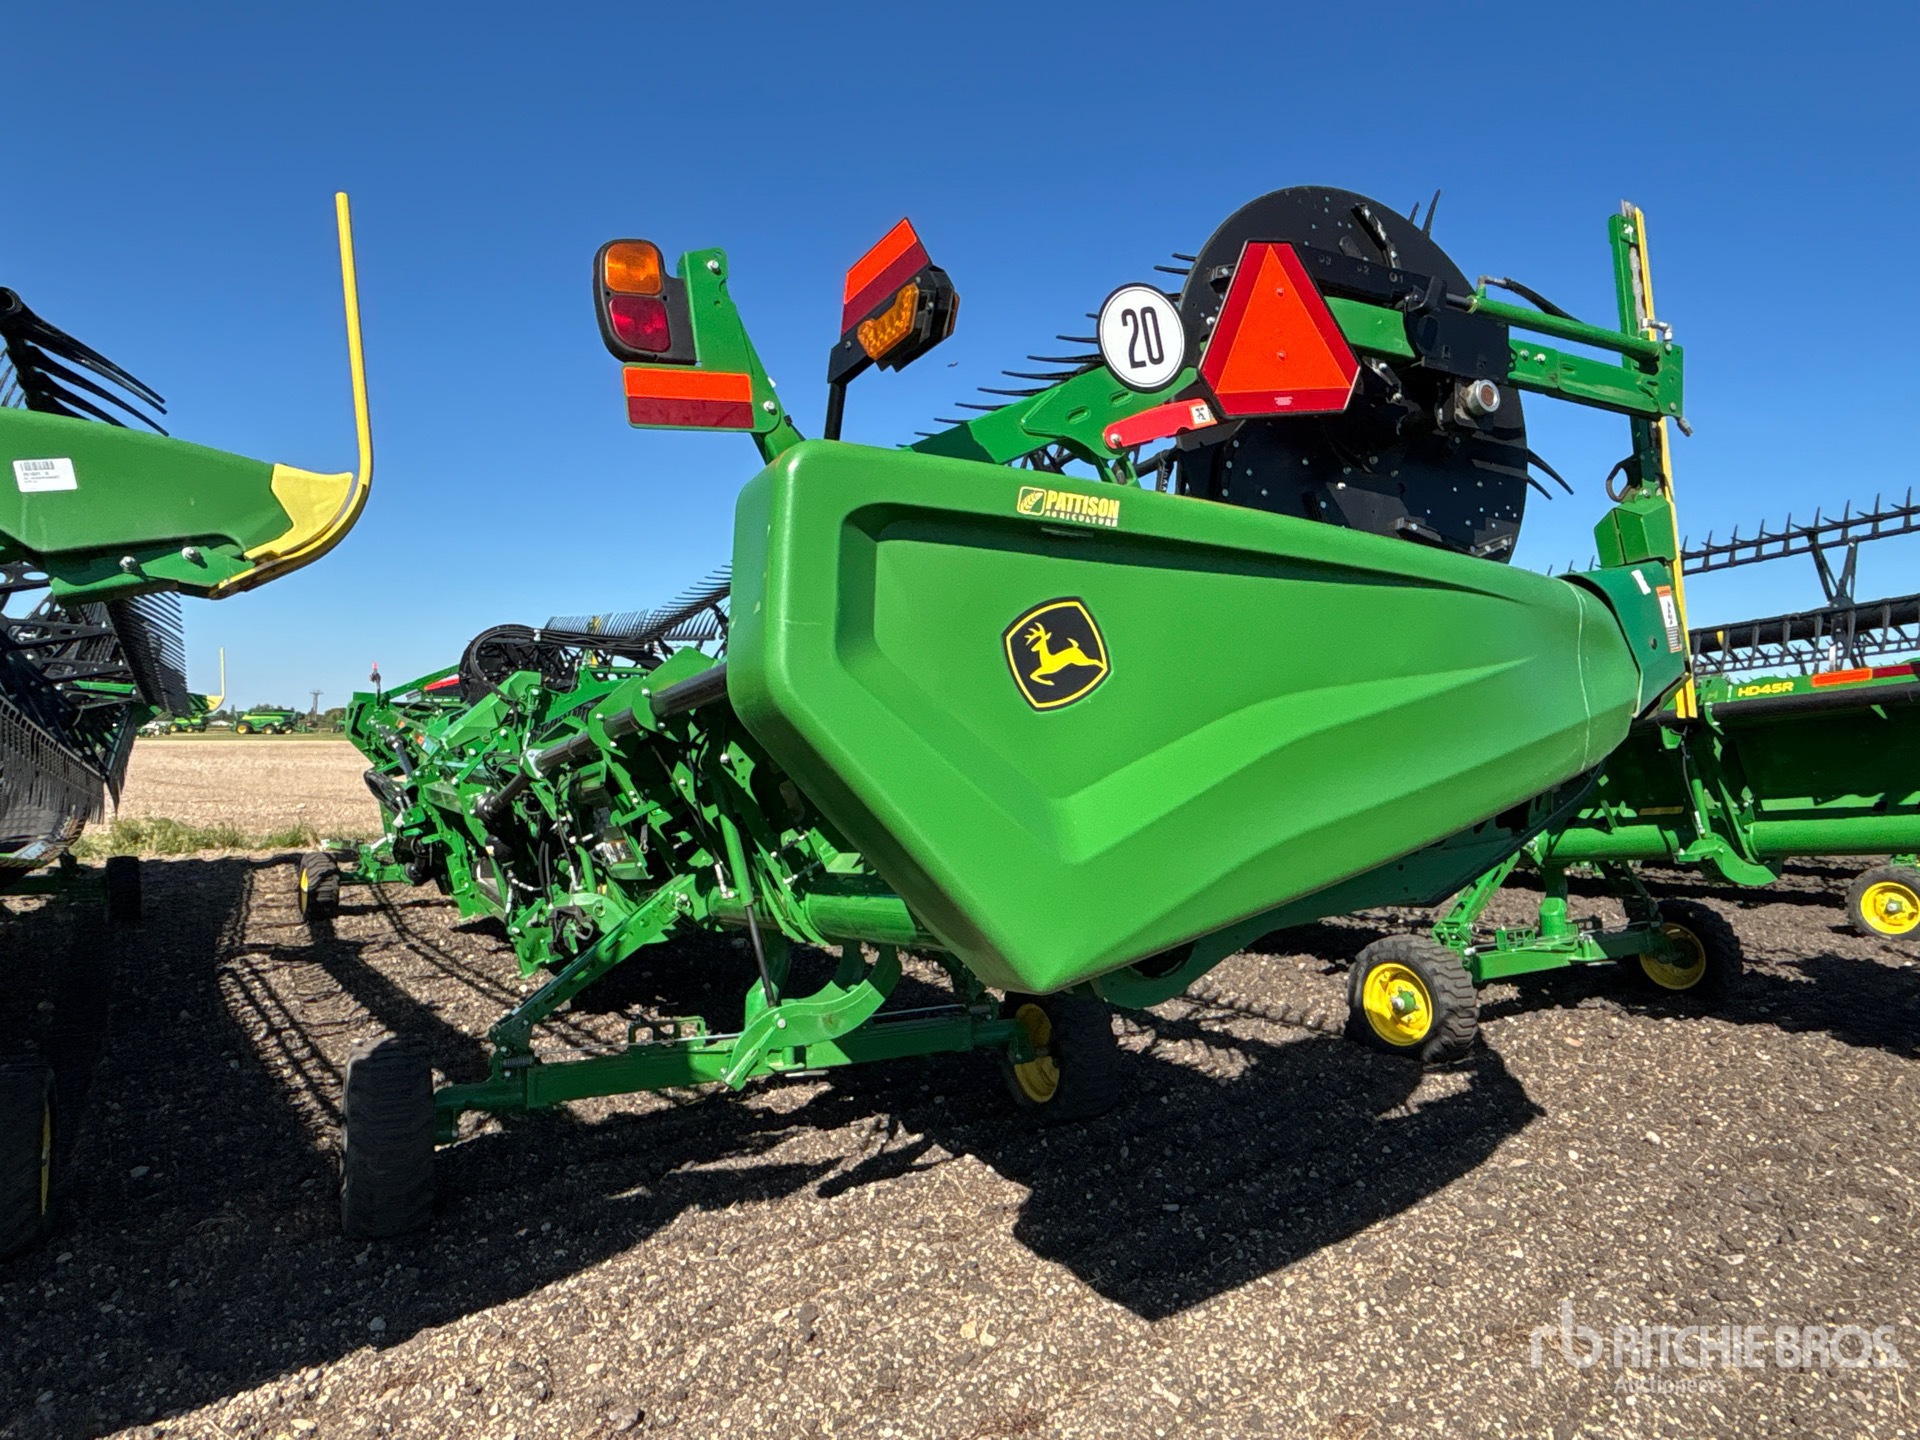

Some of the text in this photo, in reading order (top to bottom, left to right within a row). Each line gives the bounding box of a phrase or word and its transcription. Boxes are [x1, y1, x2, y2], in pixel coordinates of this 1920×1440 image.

[1121, 306, 1164, 369] 20
[1044, 510, 1118, 528] AGRICULTURE
[1045, 489, 1120, 519] PATTISON
